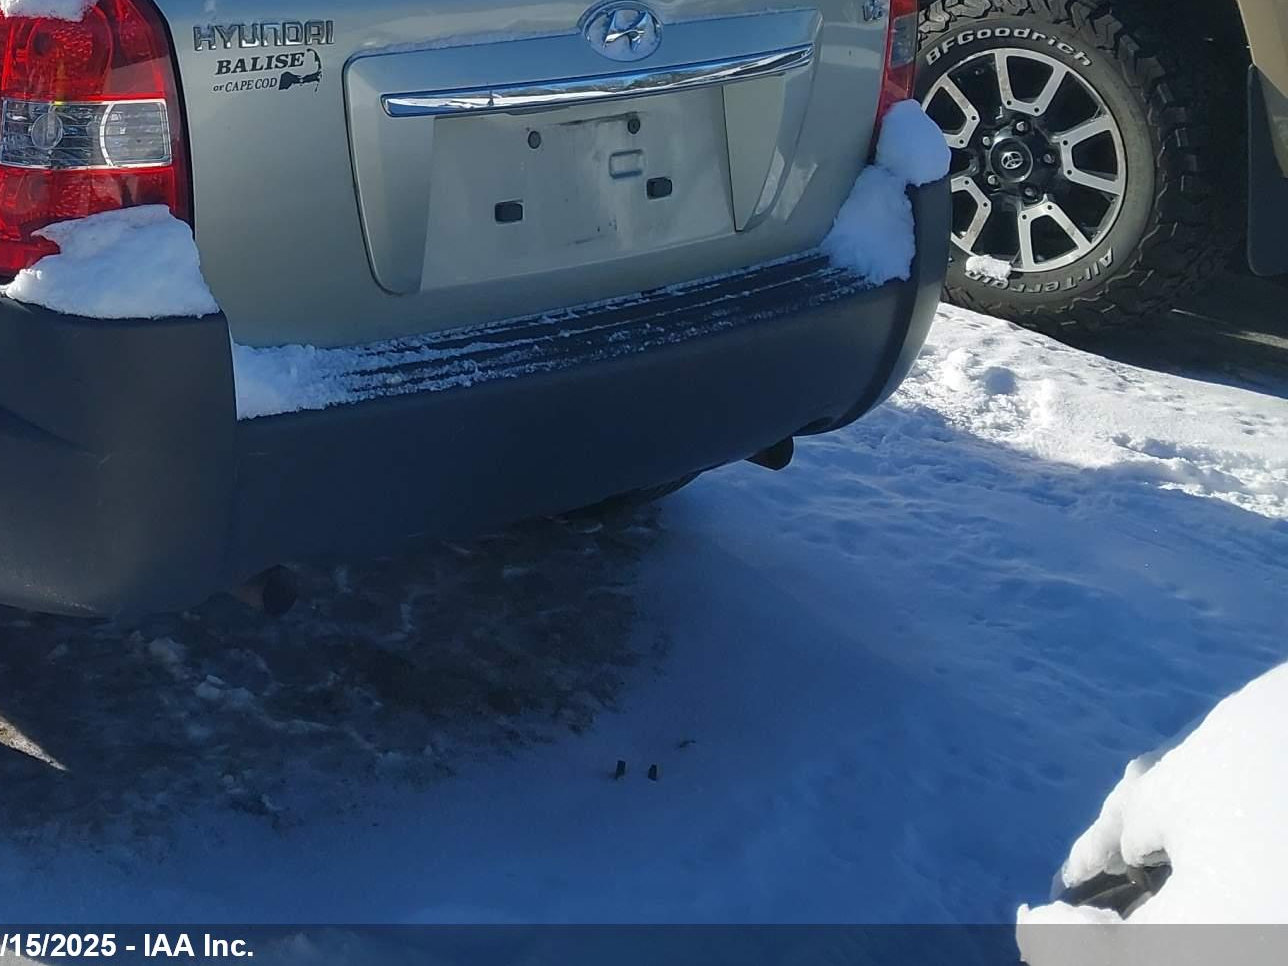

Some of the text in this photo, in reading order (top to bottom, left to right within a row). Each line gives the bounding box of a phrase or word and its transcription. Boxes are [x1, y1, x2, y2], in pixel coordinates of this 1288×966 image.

[193, 20, 334, 51] HYUNDAI
[925, 27, 1093, 66] BFGoodrich
[215, 52, 304, 75] BALISE
[225, 80, 253, 93] CAPE
[255, 77, 278, 90] COD
